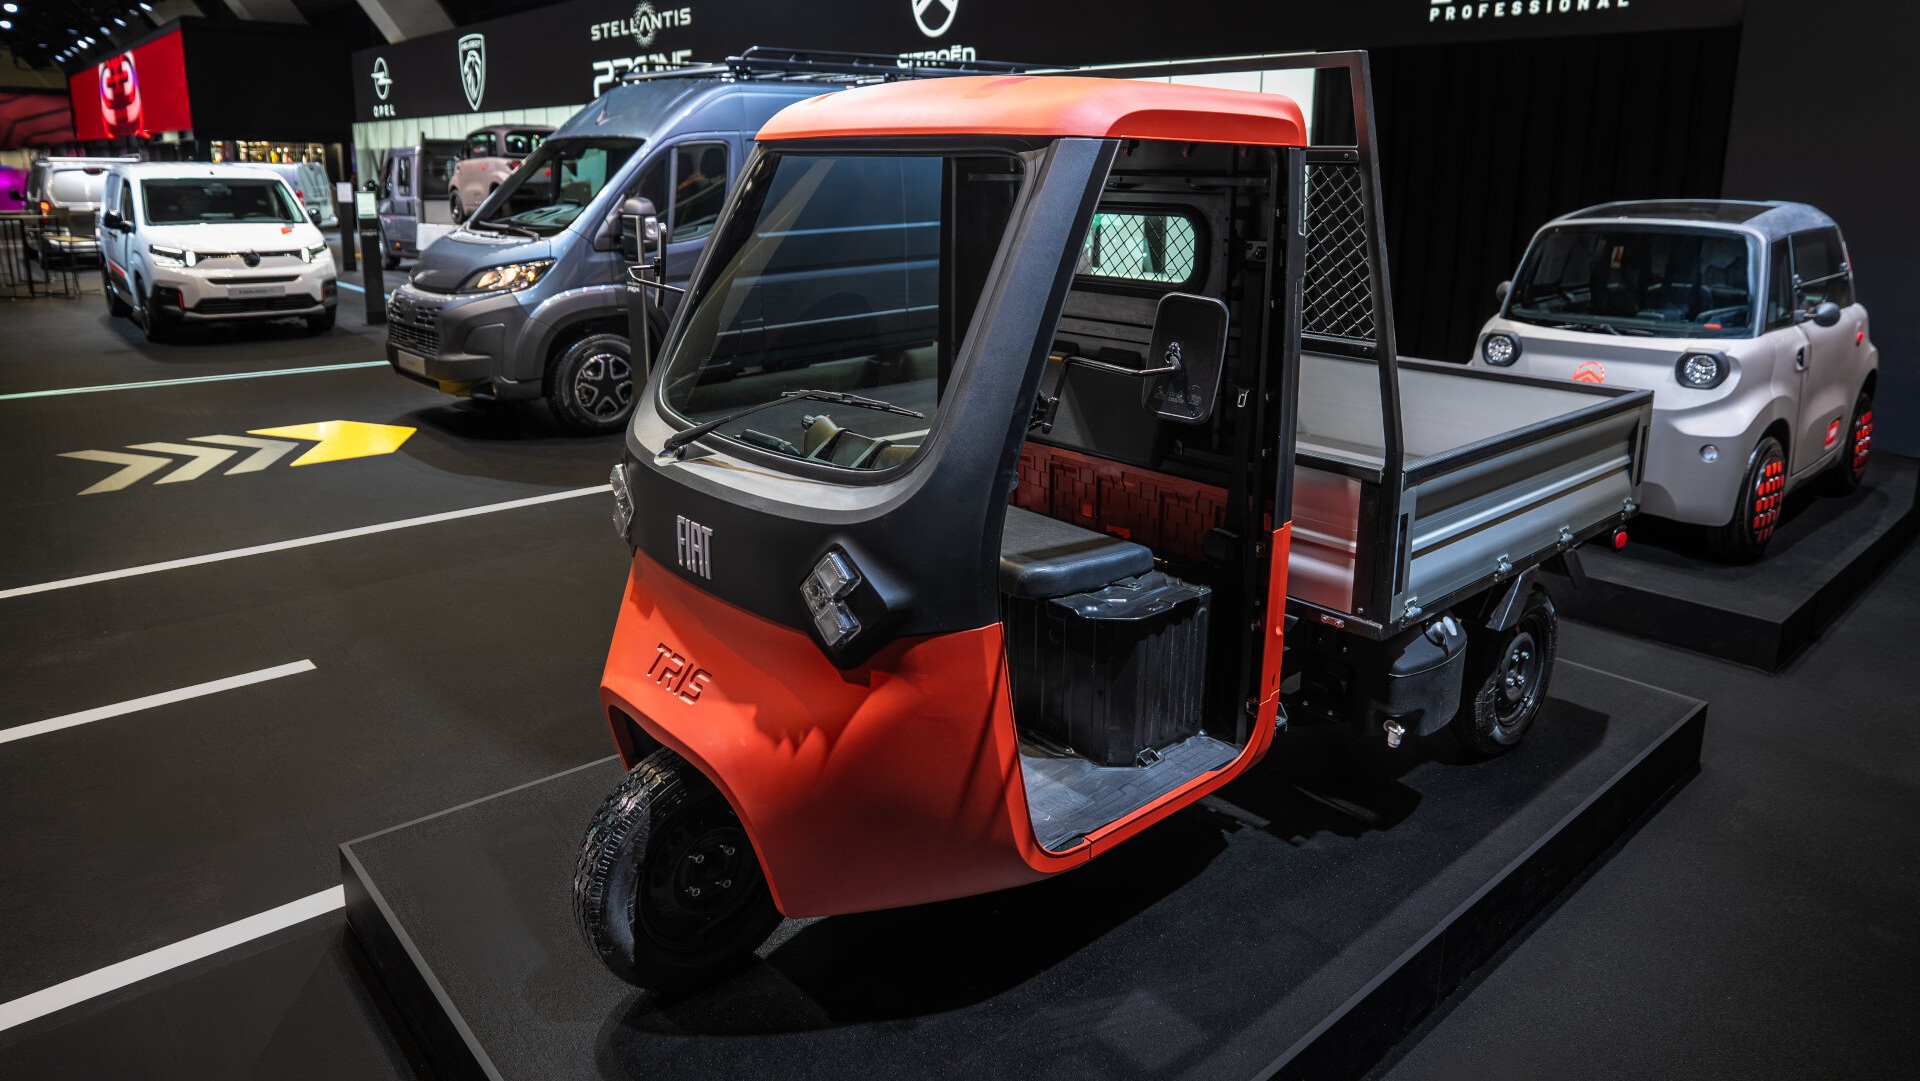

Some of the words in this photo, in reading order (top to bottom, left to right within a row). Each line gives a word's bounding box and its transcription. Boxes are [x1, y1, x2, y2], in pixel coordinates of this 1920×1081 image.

[591, 7, 690, 41] STELLANTIS
[373, 104, 396, 118] OPEL
[677, 515, 713, 580] FIAT
[647, 643, 713, 705] TRIS
